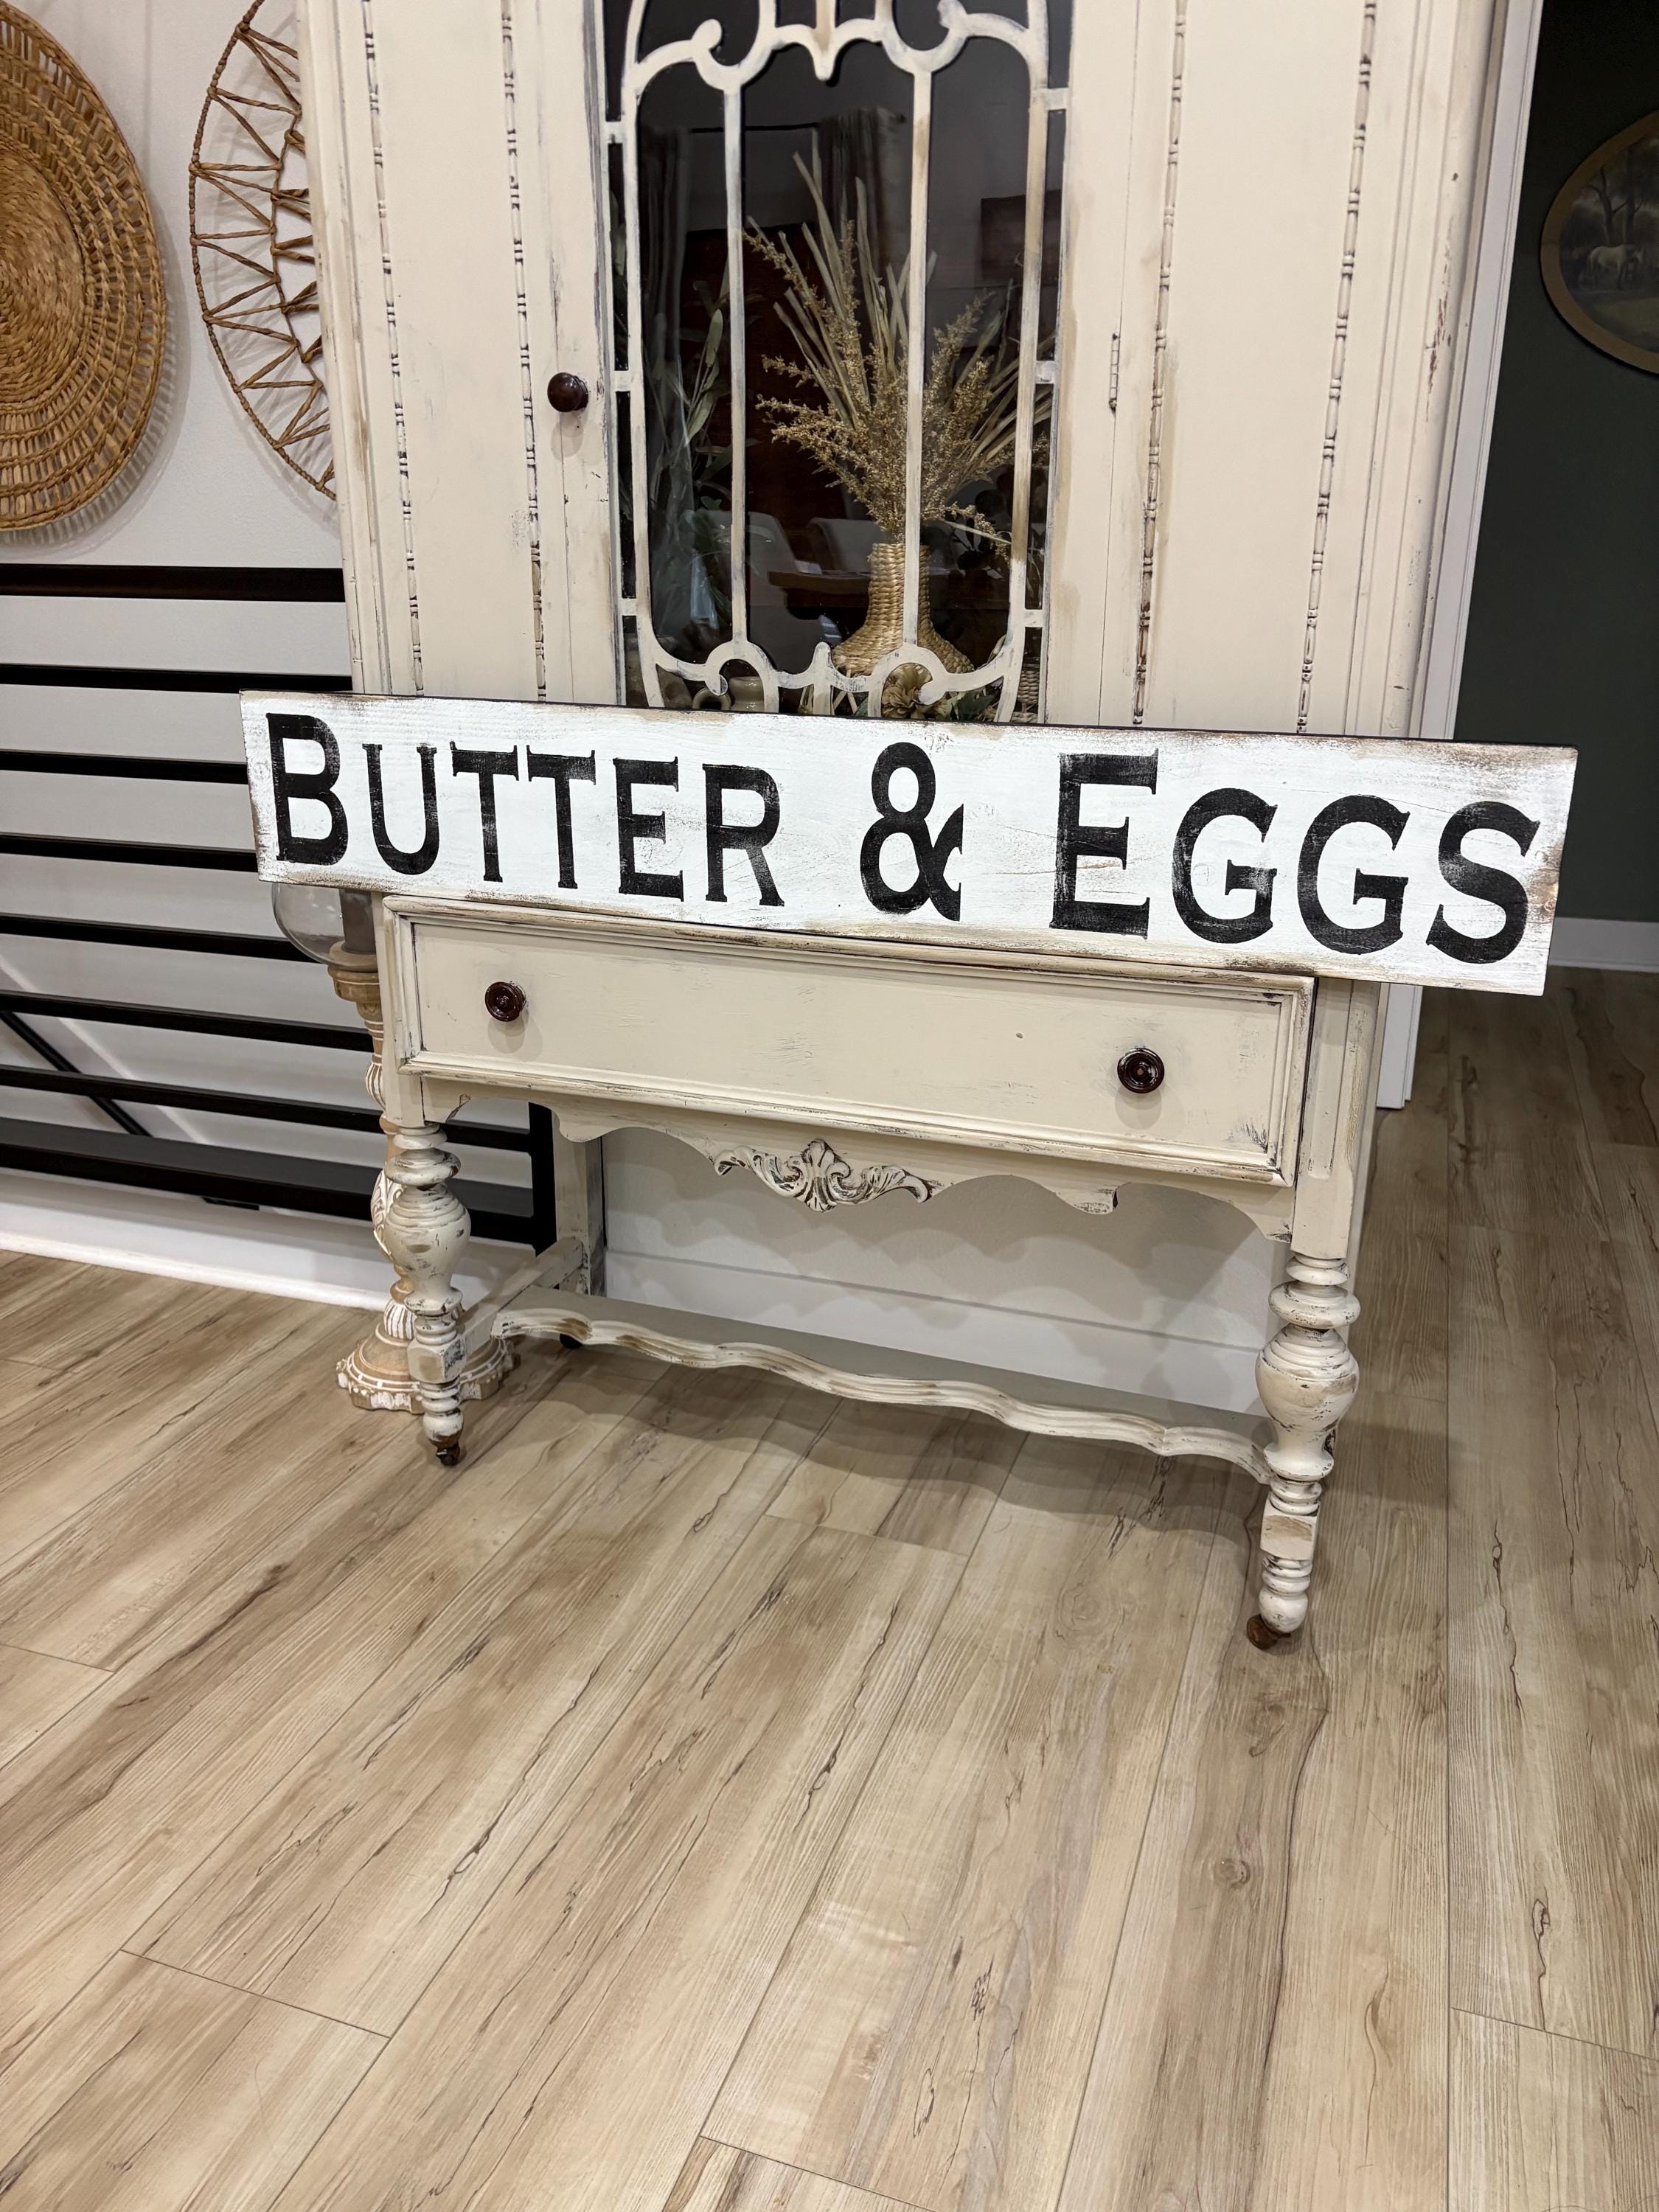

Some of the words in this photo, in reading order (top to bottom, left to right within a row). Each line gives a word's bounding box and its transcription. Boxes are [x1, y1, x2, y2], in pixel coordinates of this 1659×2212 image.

[266, 712, 785, 907] BUTTER
[860, 742, 964, 922] &
[1048, 748, 1541, 964] EGGS
